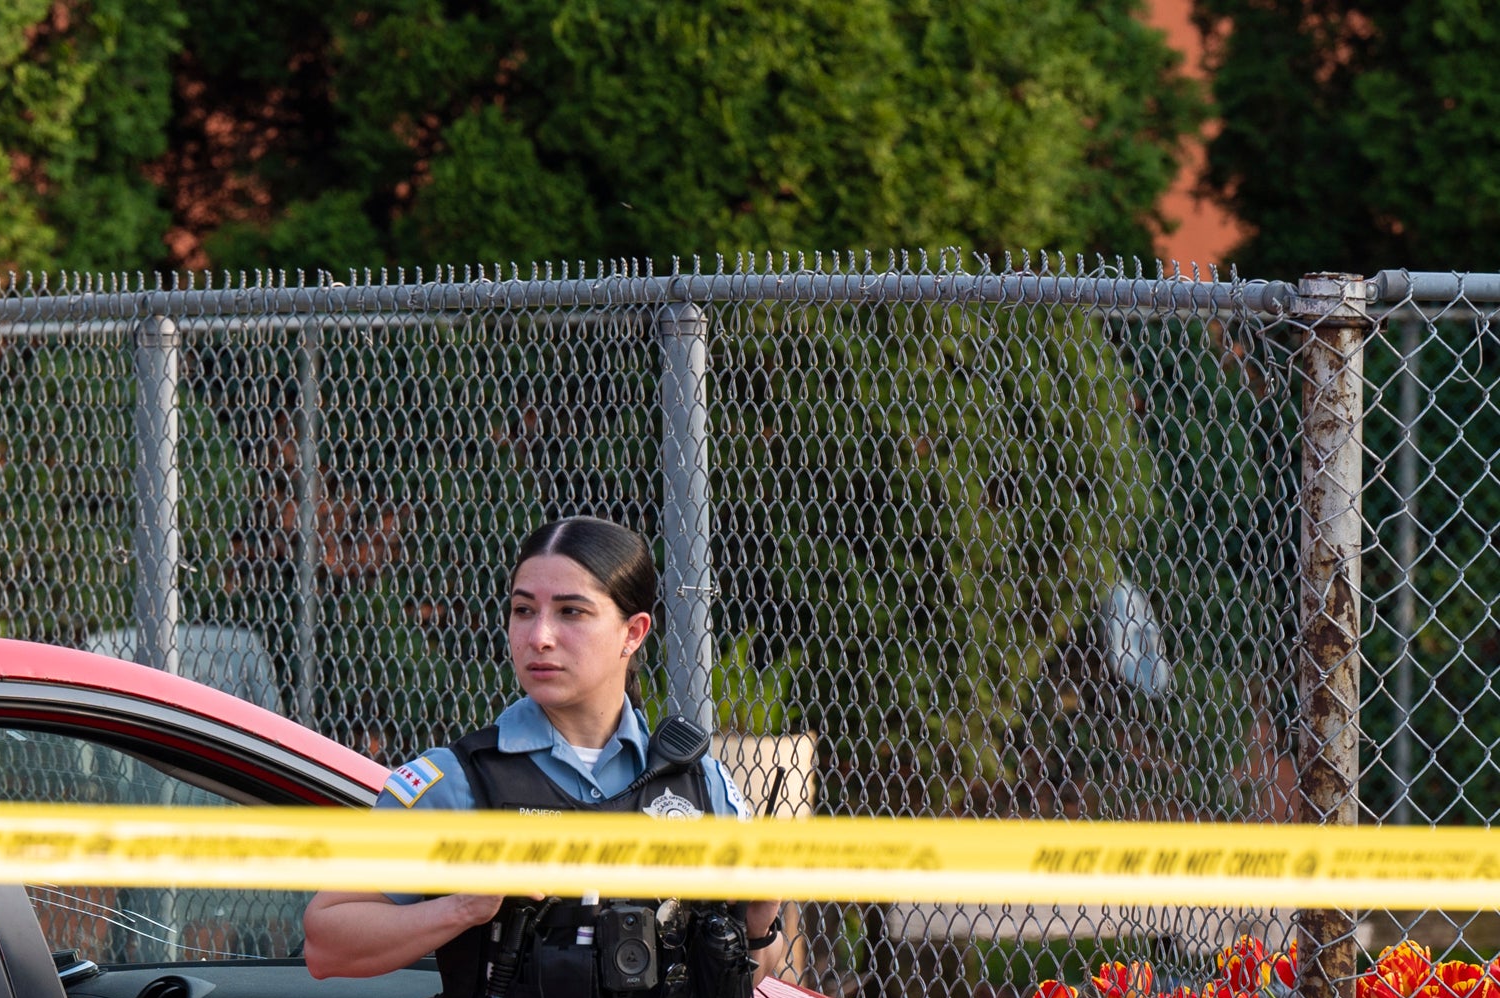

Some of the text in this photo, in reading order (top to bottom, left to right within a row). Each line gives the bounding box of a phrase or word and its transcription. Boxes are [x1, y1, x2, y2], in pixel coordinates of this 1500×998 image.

[518, 807, 562, 818] PACHECO
[429, 837, 506, 864] POLICE
[595, 840, 637, 866] NOT
[639, 840, 709, 867] CROSS
[1029, 847, 1288, 878] POLICE LINE DO NOT CROSS
